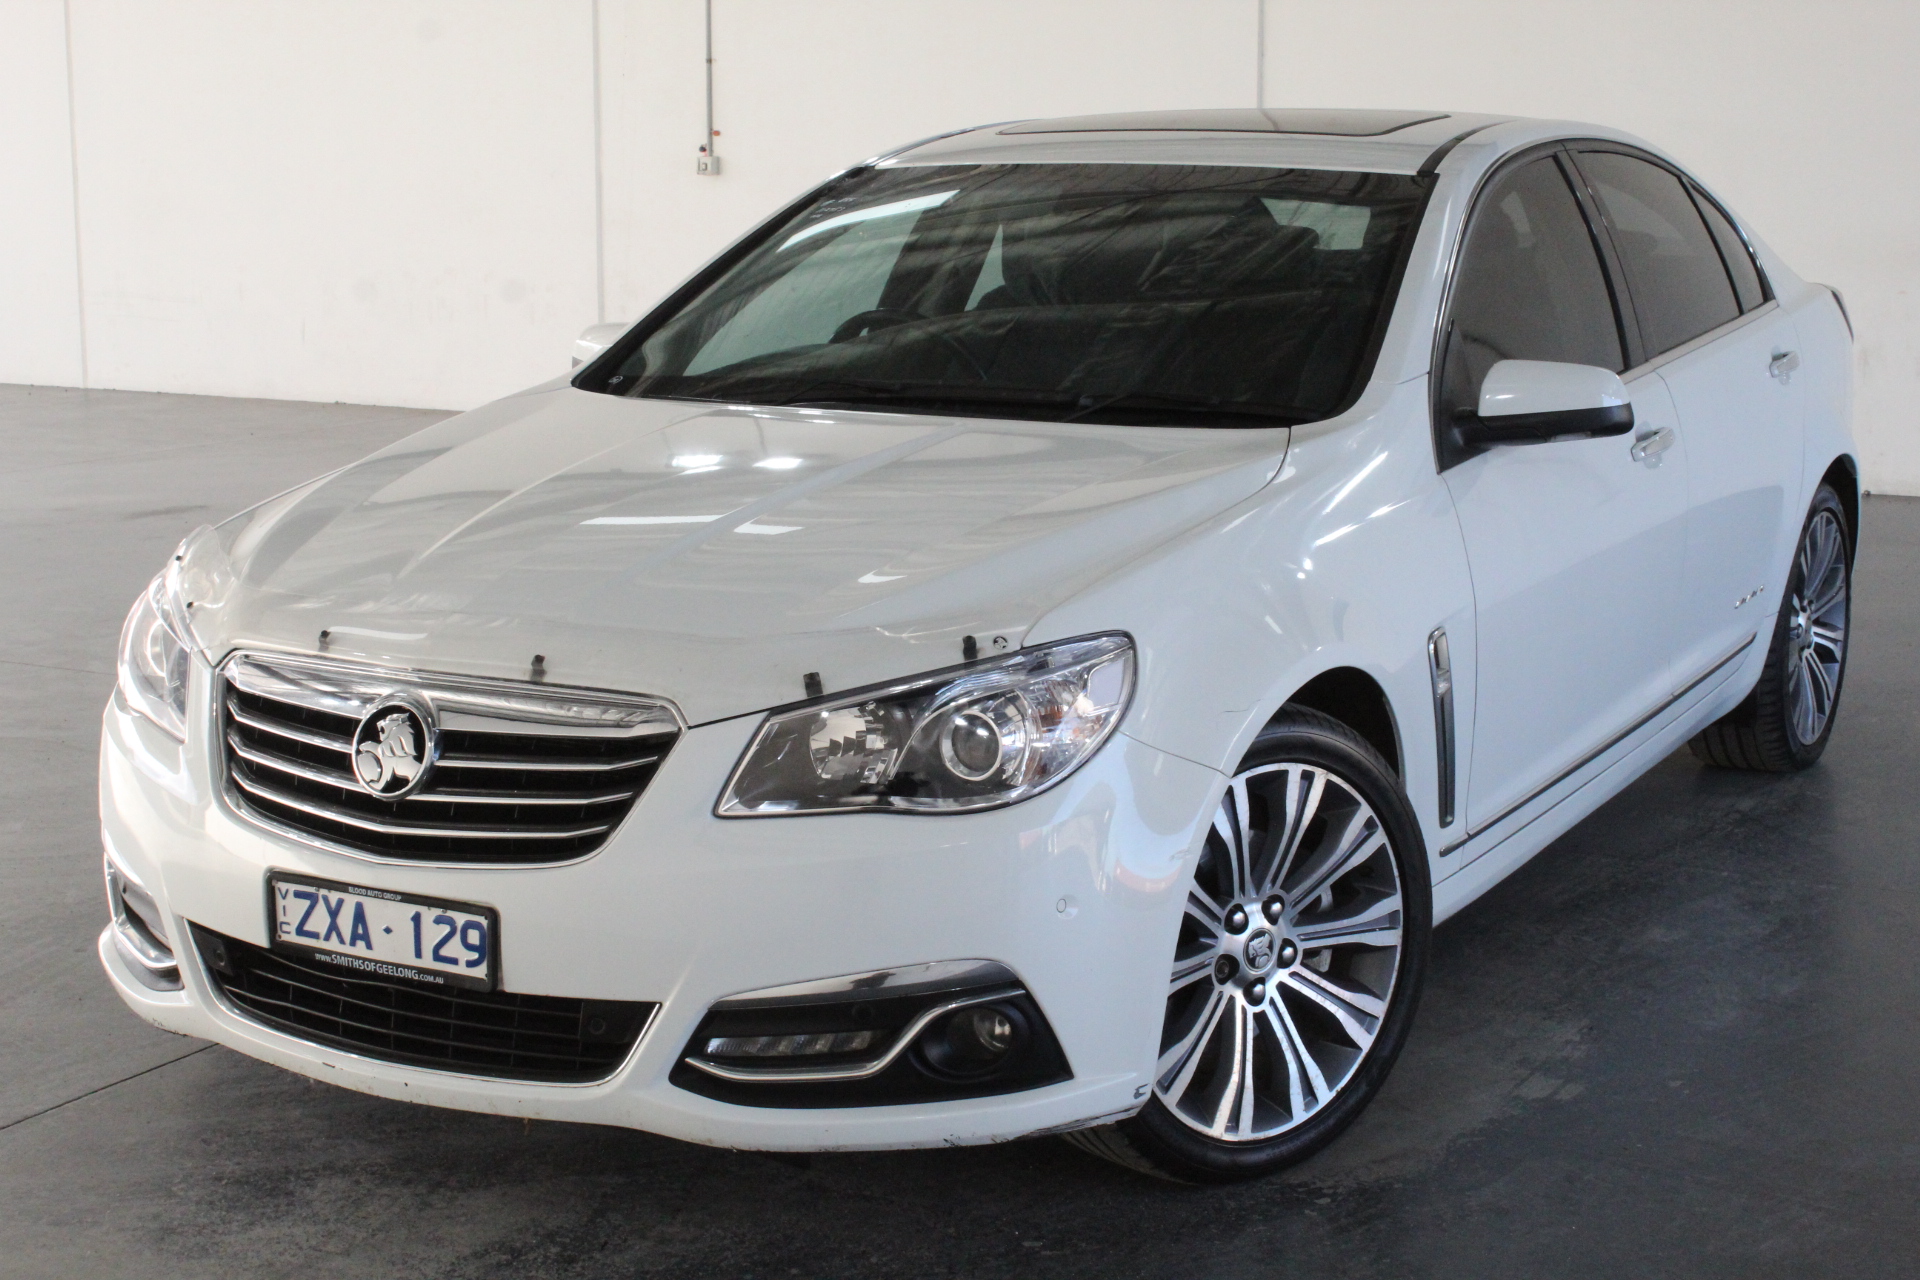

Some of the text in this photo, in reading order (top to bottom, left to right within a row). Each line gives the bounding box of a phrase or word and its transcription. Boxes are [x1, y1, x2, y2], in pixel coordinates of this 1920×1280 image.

[348, 886, 402, 901] BLOOD AUTO GROUP
